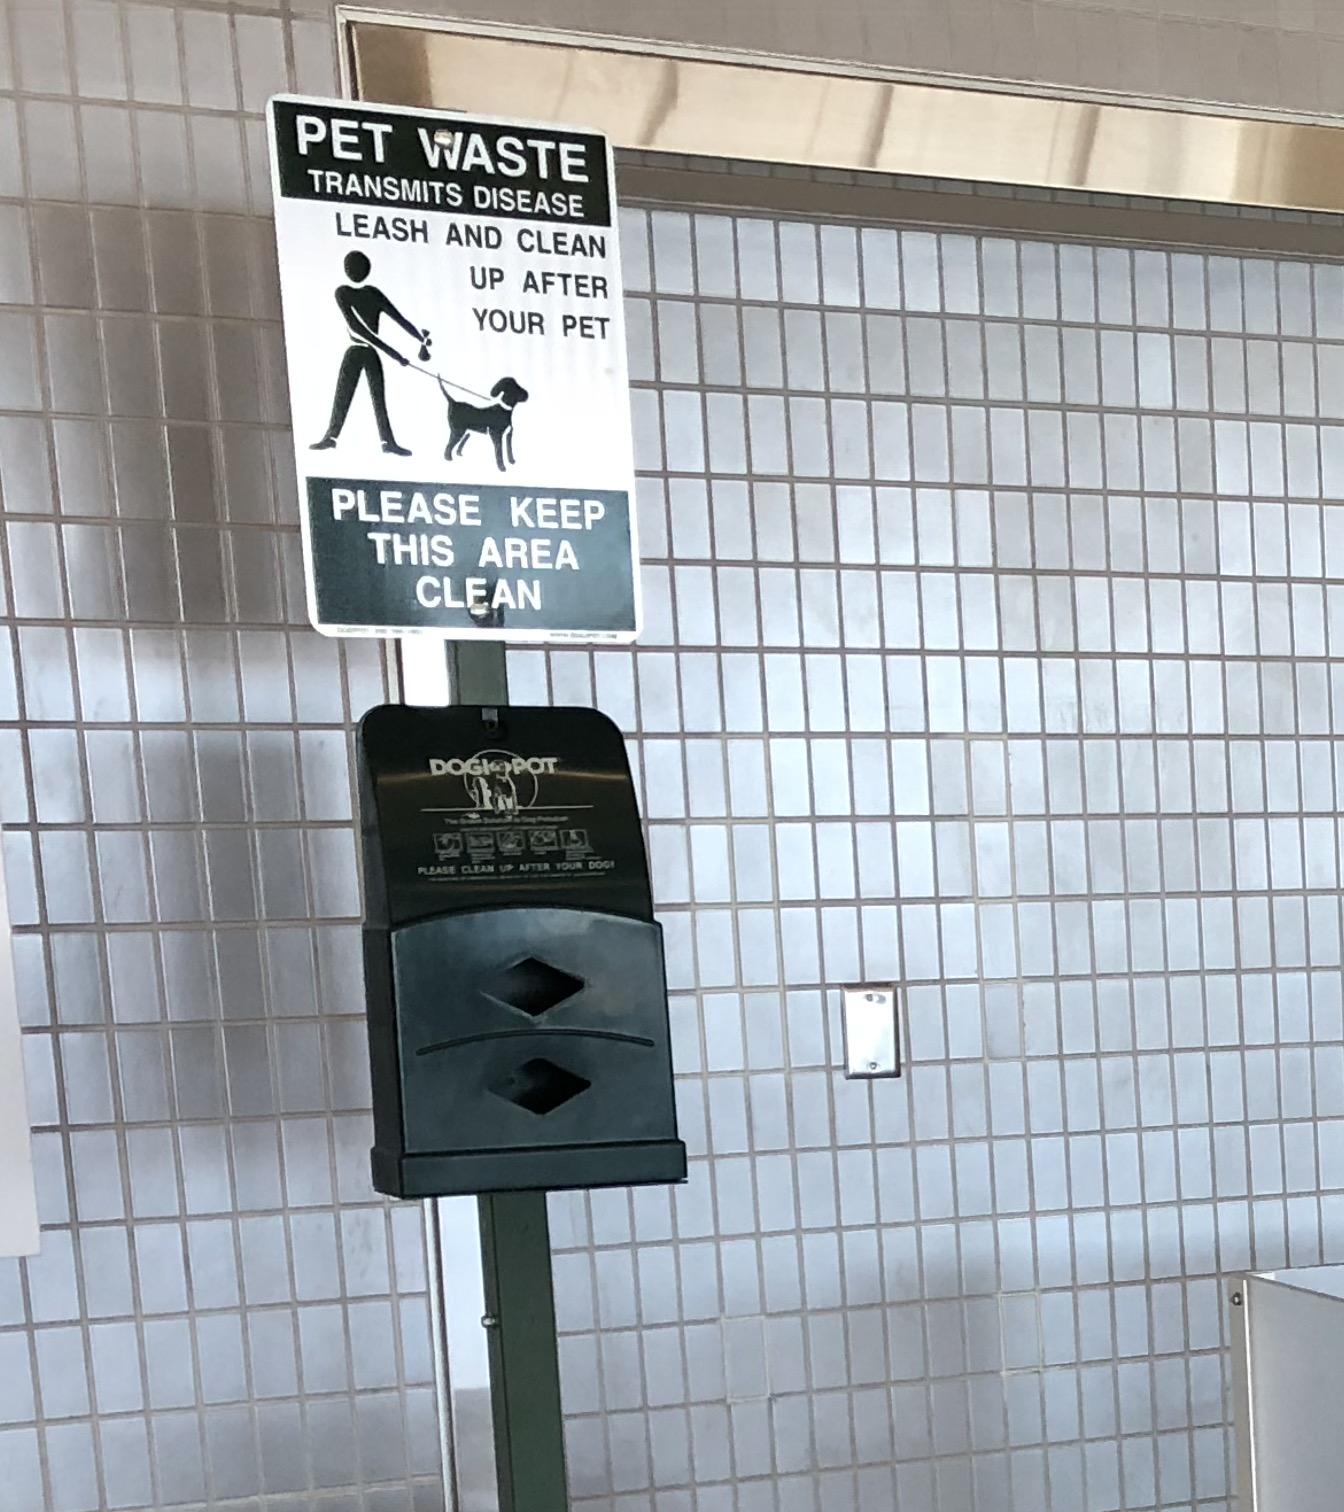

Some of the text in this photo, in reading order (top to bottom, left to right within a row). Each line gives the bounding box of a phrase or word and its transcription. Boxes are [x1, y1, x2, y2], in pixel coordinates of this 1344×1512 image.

[294, 114, 591, 184] PET WASTE
[307, 168, 585, 218] TRANSMITS DISEASE
[335, 212, 606, 258] LEASH AND CLEAN
[469, 266, 608, 299] UP AFTER
[471, 306, 611, 340] YOUR PET
[331, 488, 606, 531] PLEASE KEEP
[366, 531, 580, 571] THIS AREA
[415, 575, 542, 611] CLEAN
[418, 865, 456, 876] PLEASE
[461, 863, 494, 875] CLEAN
[499, 863, 514, 873] UP
[519, 861, 550, 872] AFTER
[556, 860, 582, 871] YOUR
